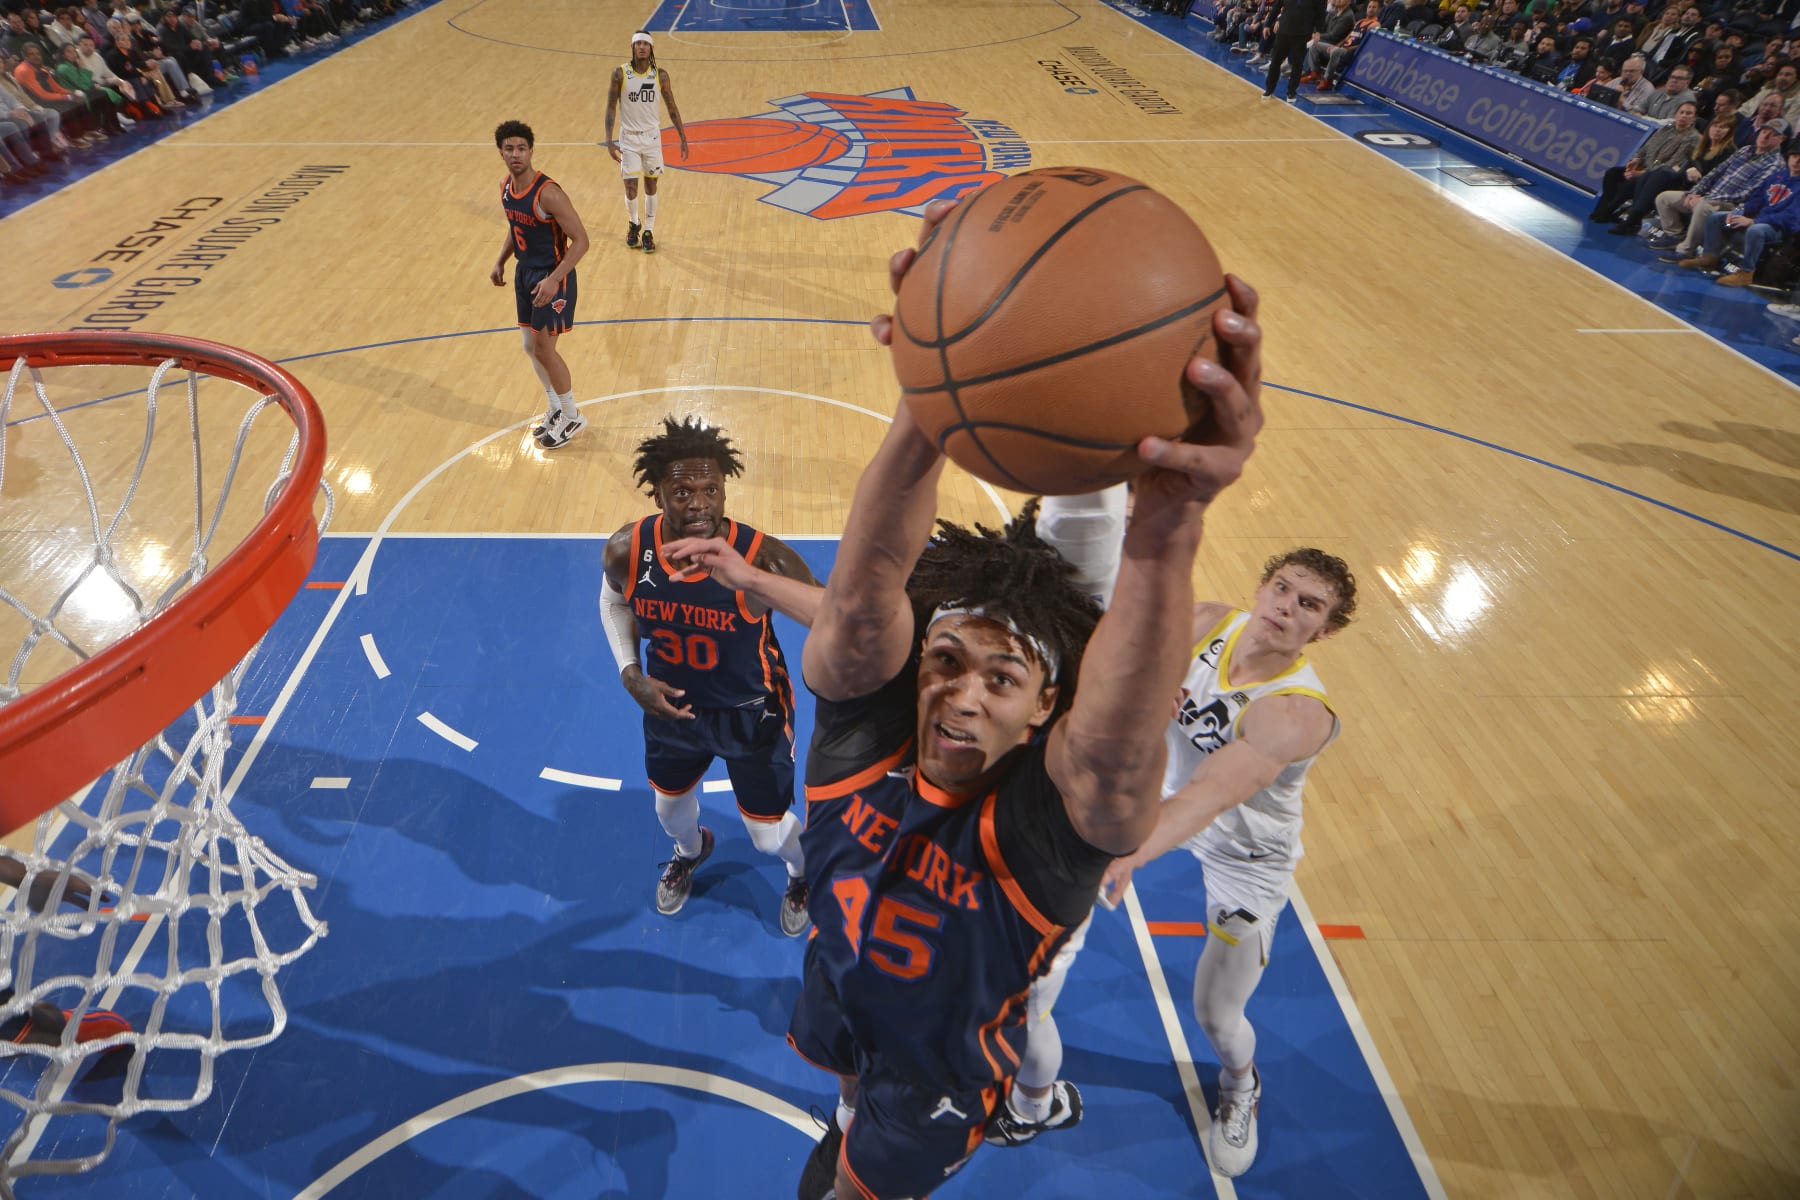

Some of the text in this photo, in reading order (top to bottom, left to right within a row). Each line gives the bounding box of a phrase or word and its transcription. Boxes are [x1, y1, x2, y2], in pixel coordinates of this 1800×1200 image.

[1037, 60, 1087, 86] CHASE
[1063, 46, 1184, 115] MADISON SQUARE GARDEN
[641, 89, 656, 103] 00
[1354, 49, 1460, 113] coinbase
[1465, 98, 1621, 179] coinbase
[962, 118, 1024, 139] NEW
[803, 91, 1009, 220] KNICKS
[987, 140, 1032, 170] YORK
[69, 164, 352, 332] MADISON SQUARE GARD
[90, 196, 224, 263] CHASE
[513, 225, 527, 252] 6
[643, 549, 653, 563] 6
[634, 597, 737, 633] NEW YORK
[651, 627, 719, 671] 30
[841, 793, 902, 864] NE
[831, 874, 945, 984] 45
